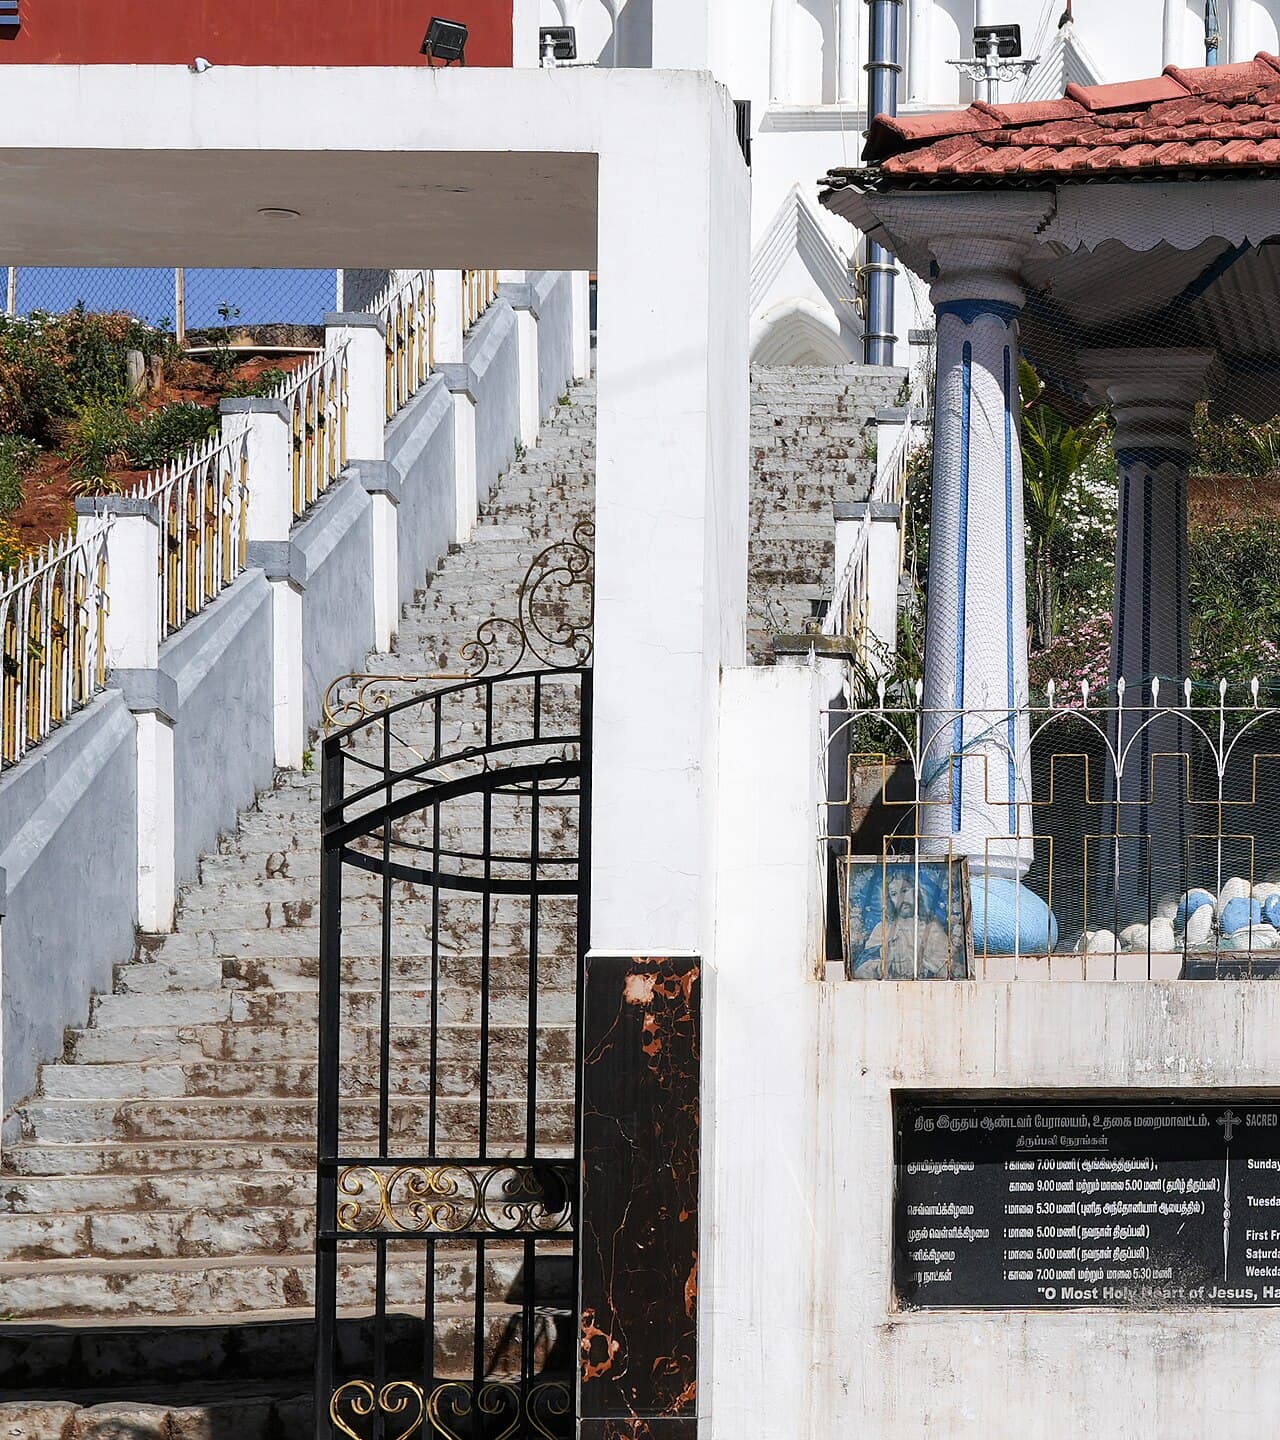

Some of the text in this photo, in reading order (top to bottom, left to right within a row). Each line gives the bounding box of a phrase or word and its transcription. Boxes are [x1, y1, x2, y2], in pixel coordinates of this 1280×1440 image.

[914, 1116, 934, 1131] திரு
[937, 1115, 978, 1132] இருதய
[980, 1115, 1032, 1130] ஆண்டவர்
[1093, 1115, 1131, 1130] உதகை
[1246, 1114, 1277, 1126] SACRED
[1247, 1230, 1268, 1240] First
[1038, 1287, 1056, 1299] "O
[1062, 1287, 1098, 1299] Most
[1207, 1286, 1257, 1301] Jesus,
